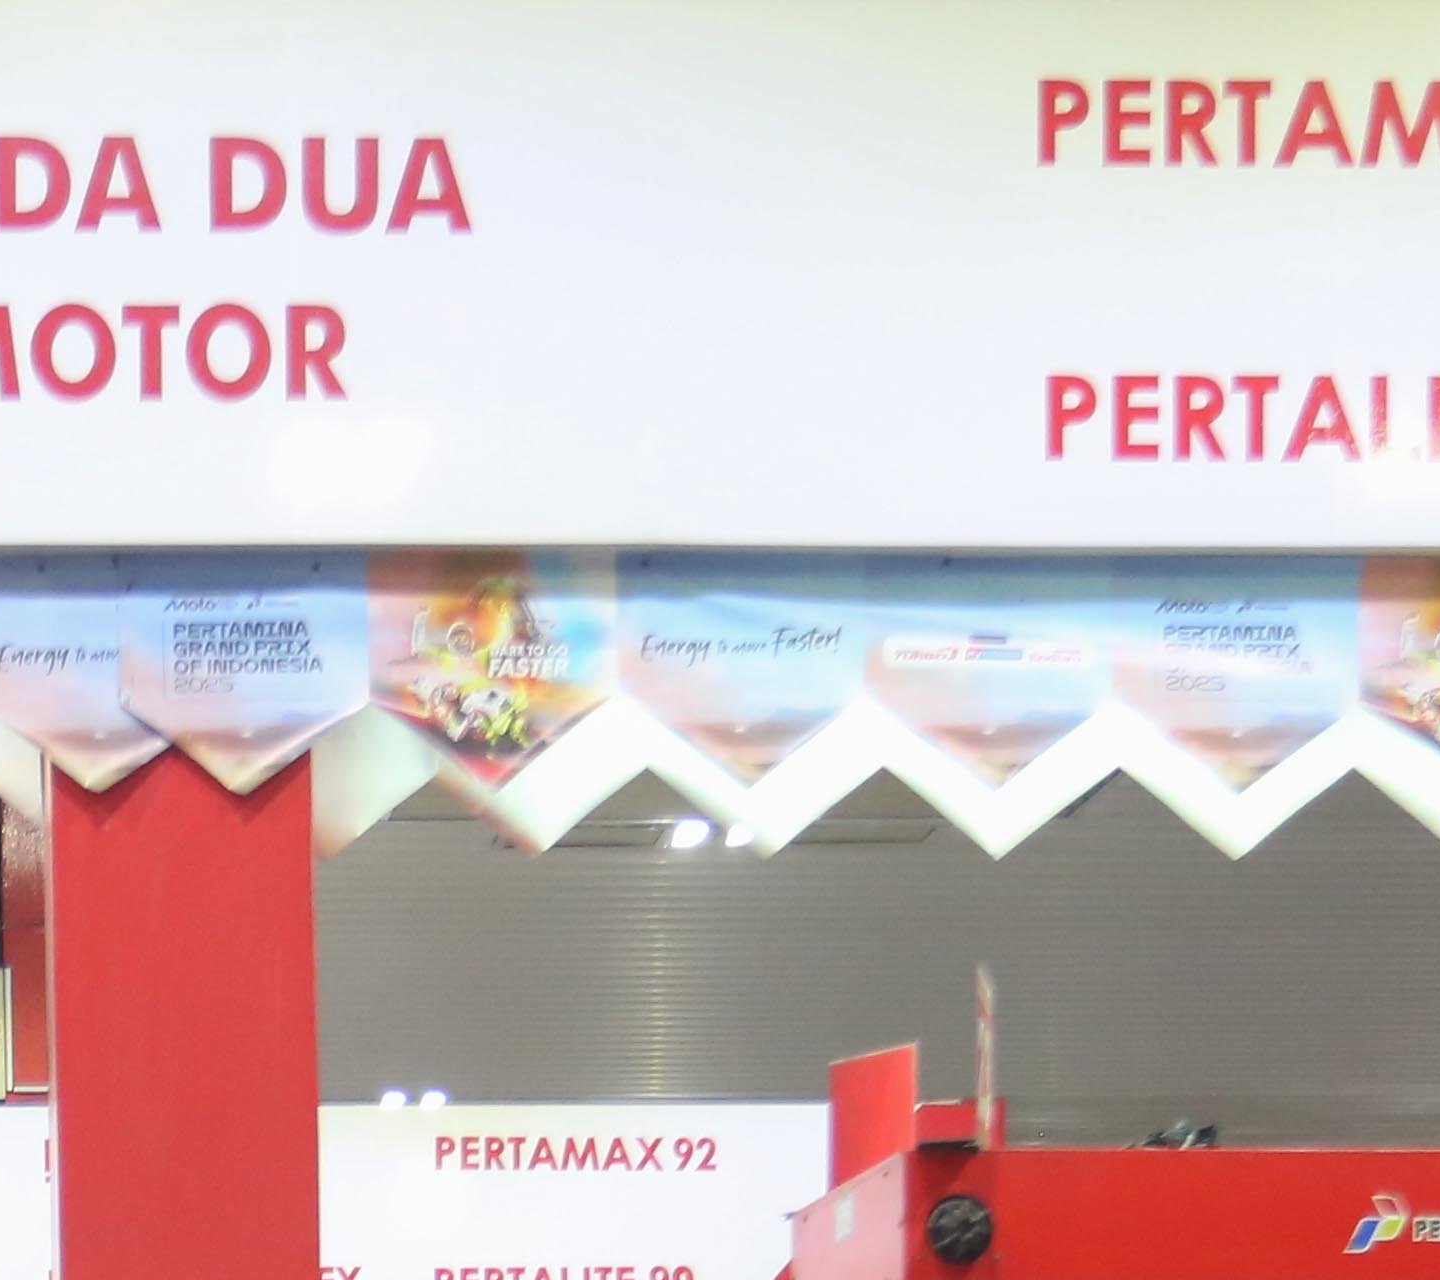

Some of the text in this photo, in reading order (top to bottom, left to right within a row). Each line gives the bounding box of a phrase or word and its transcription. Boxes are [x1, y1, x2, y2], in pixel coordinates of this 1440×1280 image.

[209, 135, 472, 236] DUA
[434, 1136, 718, 1171] PERTAMAX 92
